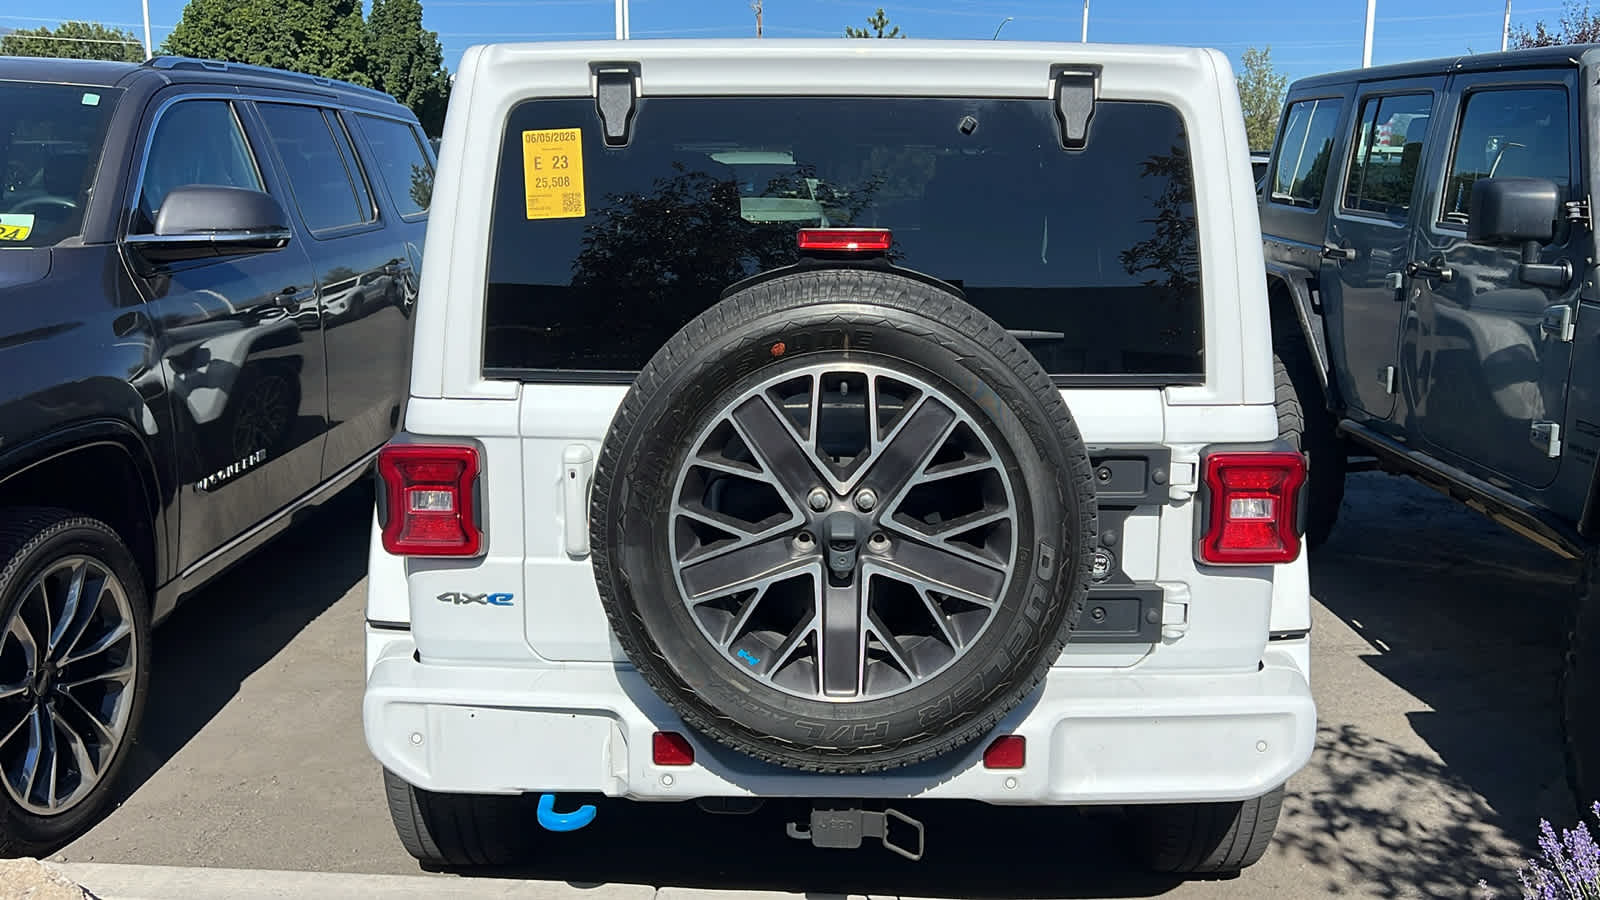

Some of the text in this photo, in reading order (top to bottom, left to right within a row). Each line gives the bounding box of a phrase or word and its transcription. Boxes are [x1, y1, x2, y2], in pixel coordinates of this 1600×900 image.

[525, 131, 576, 144] 06/05/2026
[534, 155, 569, 170] E 23
[535, 176, 570, 189] 25,508
